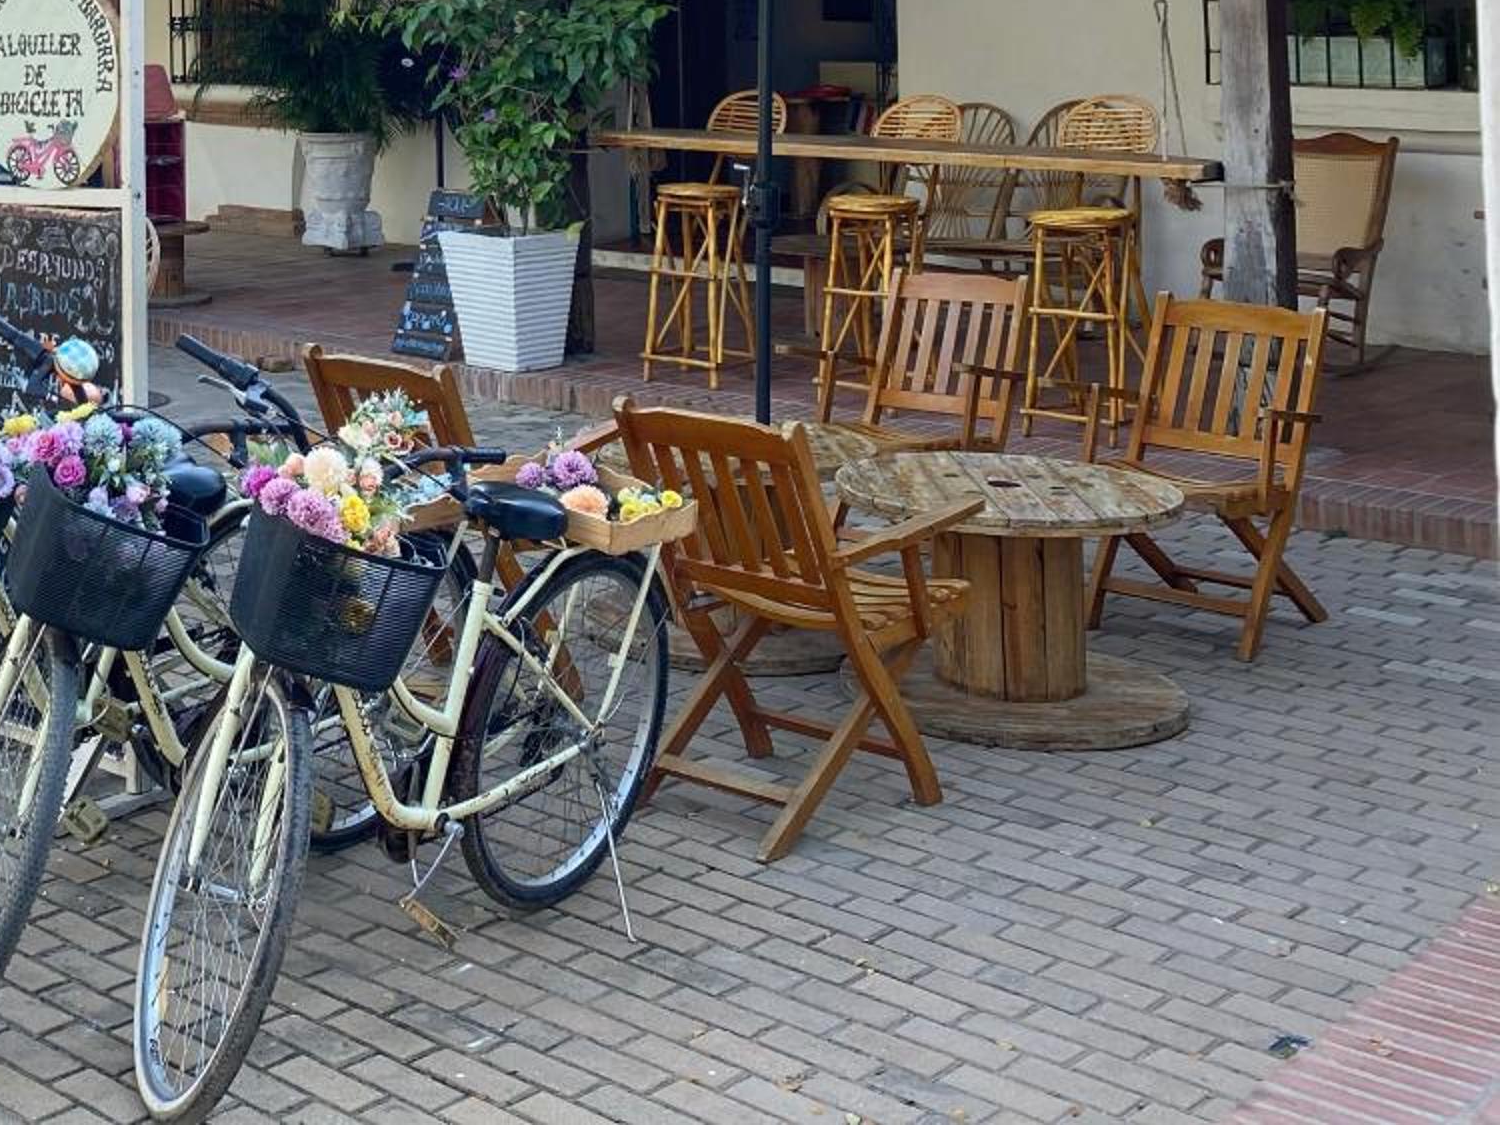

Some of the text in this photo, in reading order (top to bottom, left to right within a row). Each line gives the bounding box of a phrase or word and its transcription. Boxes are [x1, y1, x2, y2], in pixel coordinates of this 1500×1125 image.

[23, 64, 46, 87] DE
[0, 88, 84, 117] BICICLETA
[0, 244, 105, 288] DESAYUNOS
